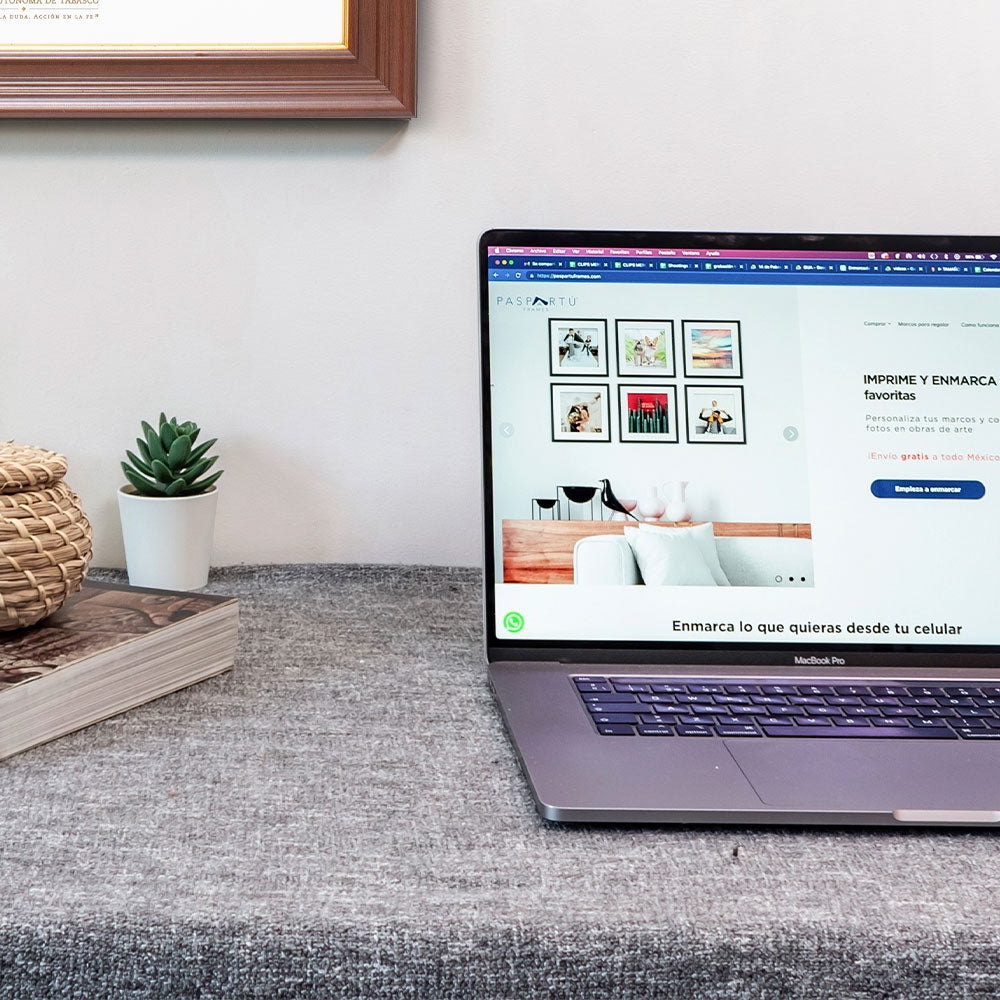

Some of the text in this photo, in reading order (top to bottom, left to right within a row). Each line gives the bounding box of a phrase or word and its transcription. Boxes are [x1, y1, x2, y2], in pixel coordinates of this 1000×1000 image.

[864, 375, 997, 386] IMPRIME Y ENMARCA
[864, 390, 916, 400] favoritas
[865, 415, 920, 423] Personaliza
[979, 417, 985, 425] y
[909, 425, 935, 433] obras
[901, 452, 929, 462] gratis
[941, 453, 963, 461] todo
[672, 620, 963, 635] Enmarca lo que quieras desde tu celular
[795, 656, 845, 665] MacBook Pro
